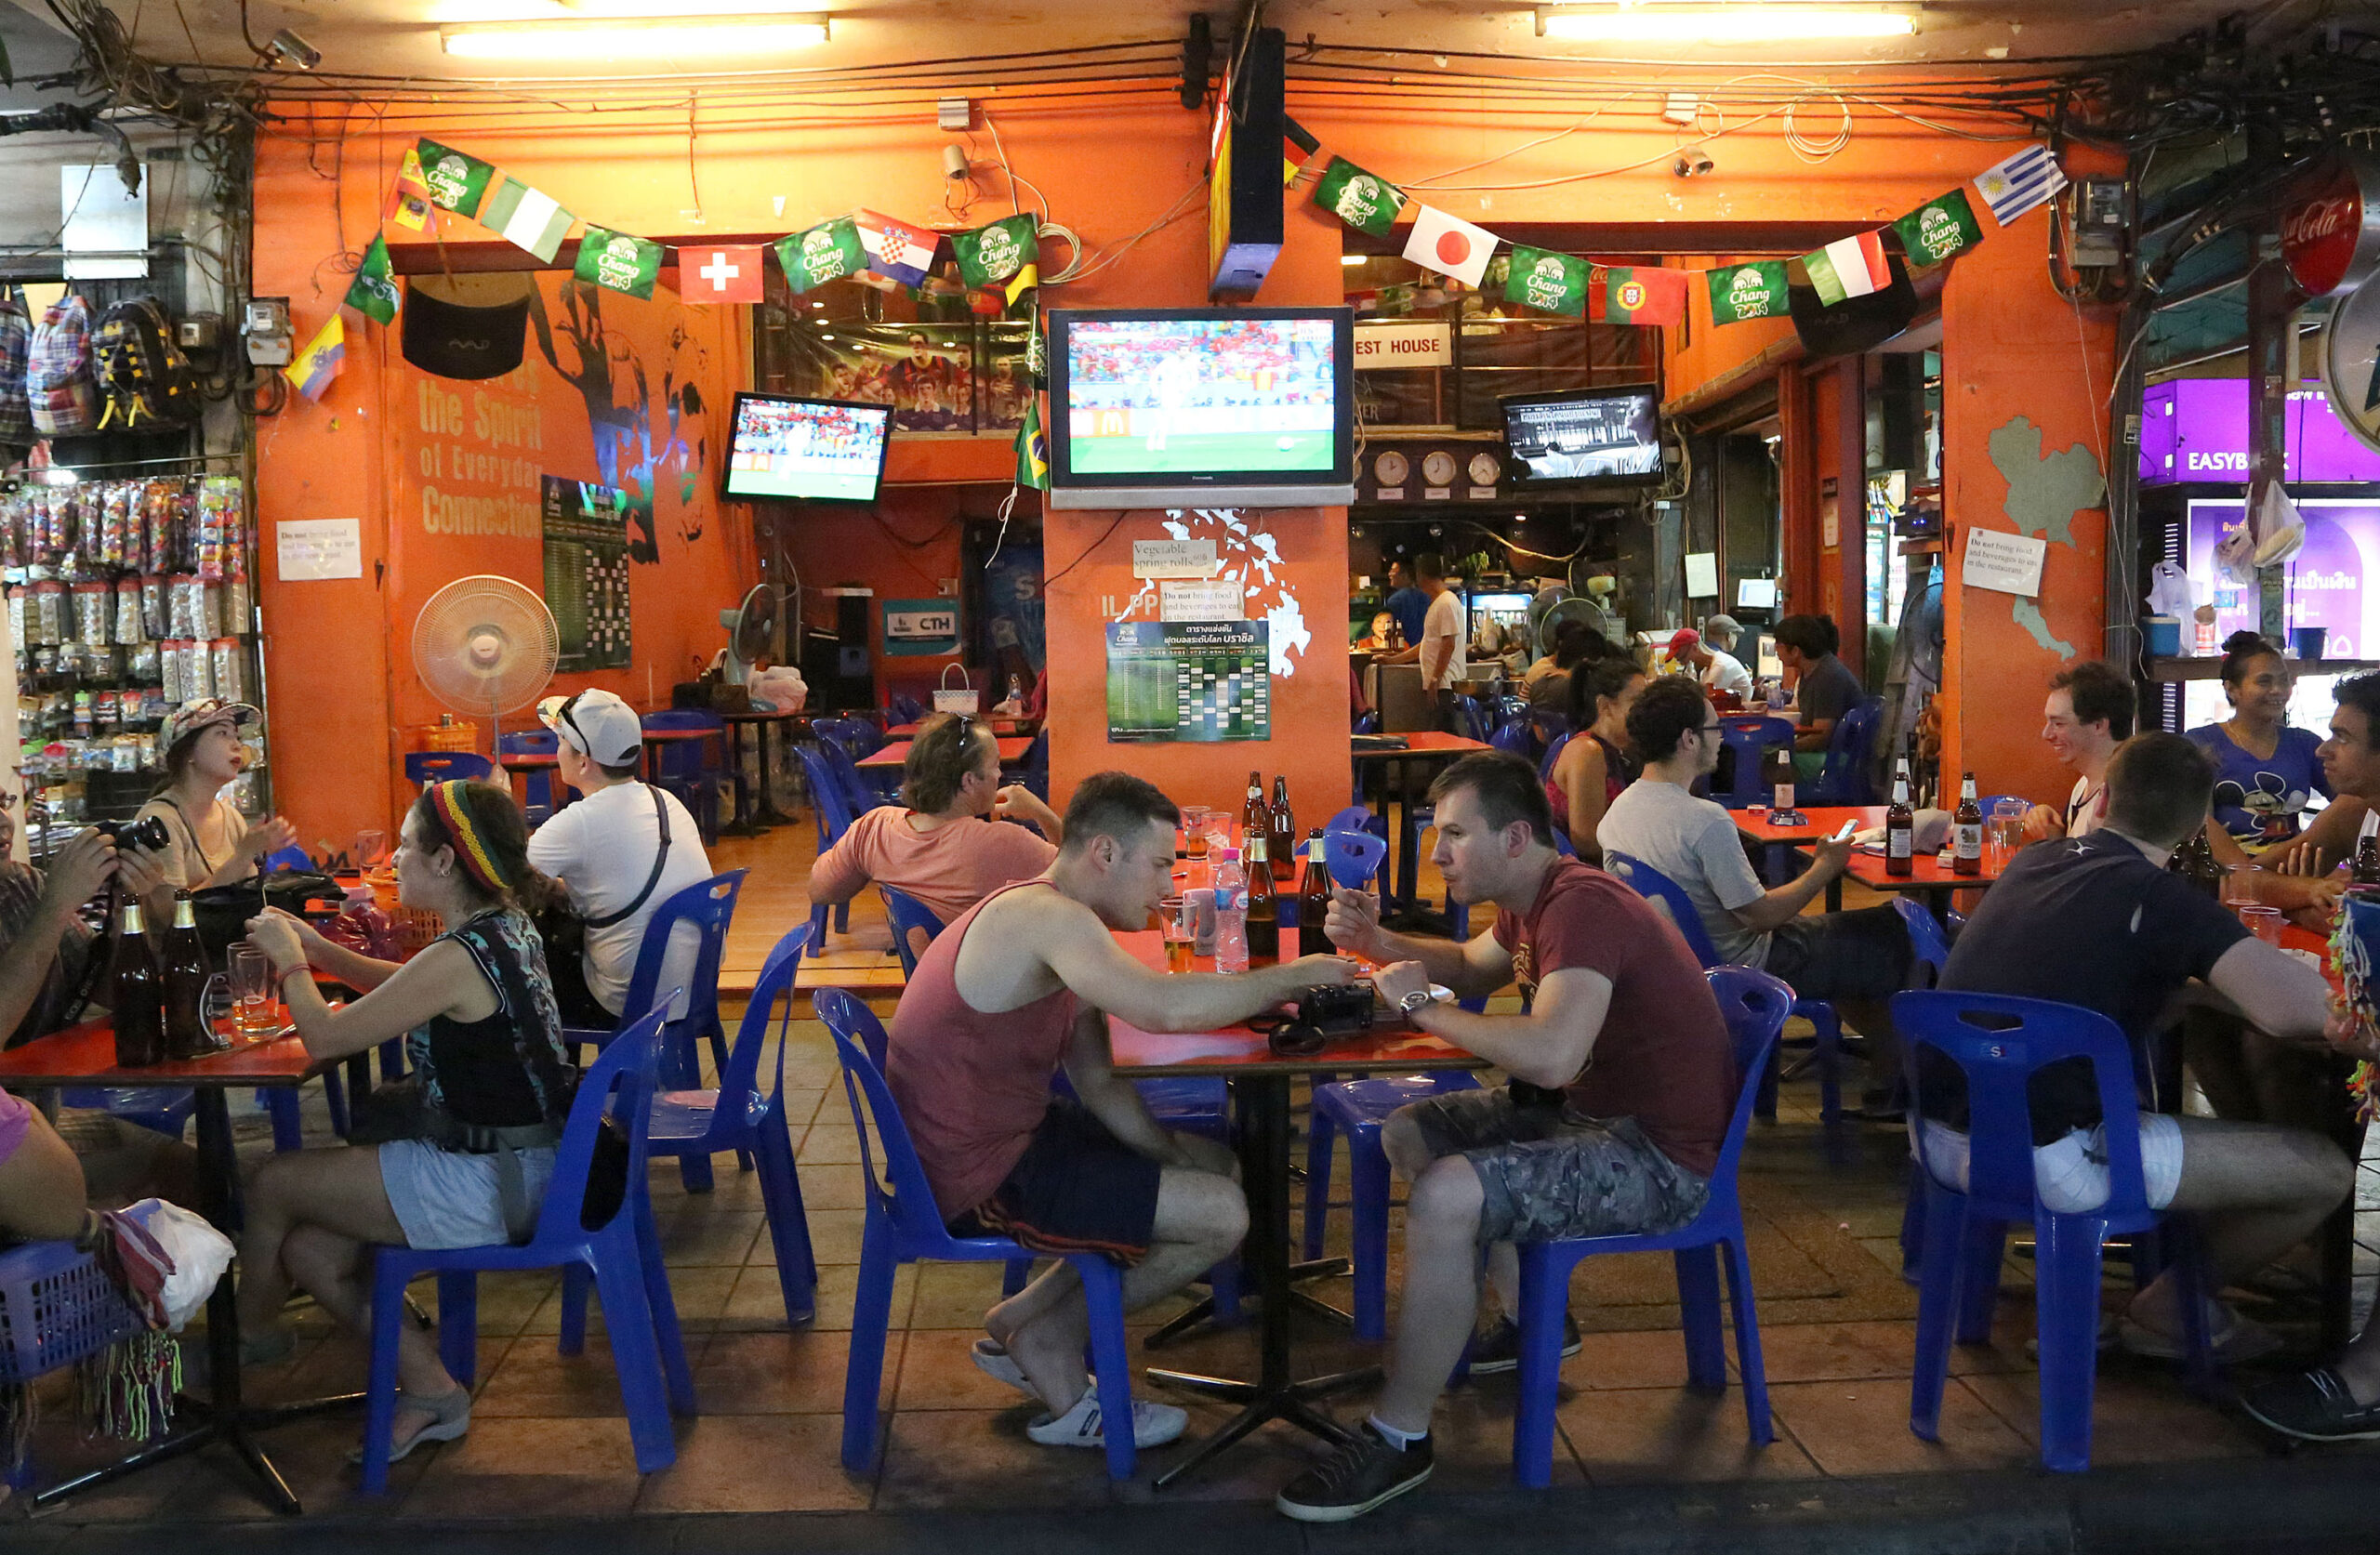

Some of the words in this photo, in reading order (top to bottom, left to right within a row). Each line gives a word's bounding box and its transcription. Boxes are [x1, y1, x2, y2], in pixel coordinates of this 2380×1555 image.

[428, 170, 468, 197] Chang
[1921, 221, 1960, 246] Chang
[803, 248, 843, 270] Chang
[979, 244, 1020, 265] Chang
[598, 254, 640, 279] Chang
[1527, 274, 1567, 297] Chang
[1730, 290, 1770, 304] Chang
[1355, 340, 1382, 355] EST
[1391, 338, 1440, 353] HOUSE
[419, 379, 464, 437] the
[474, 390, 542, 450] Spirit
[420, 442, 442, 478] of
[452, 445, 542, 493] Everyday
[2188, 452, 2289, 470] EASYB
[1134, 544, 1186, 557] Vegetable
[1135, 560, 1167, 570] spring
[1170, 558, 1193, 567] rolls
[1193, 591, 1212, 600] bring
[1215, 590, 1232, 600] food
[1180, 602, 1218, 612] beverages
[919, 617, 950, 631] CTH
